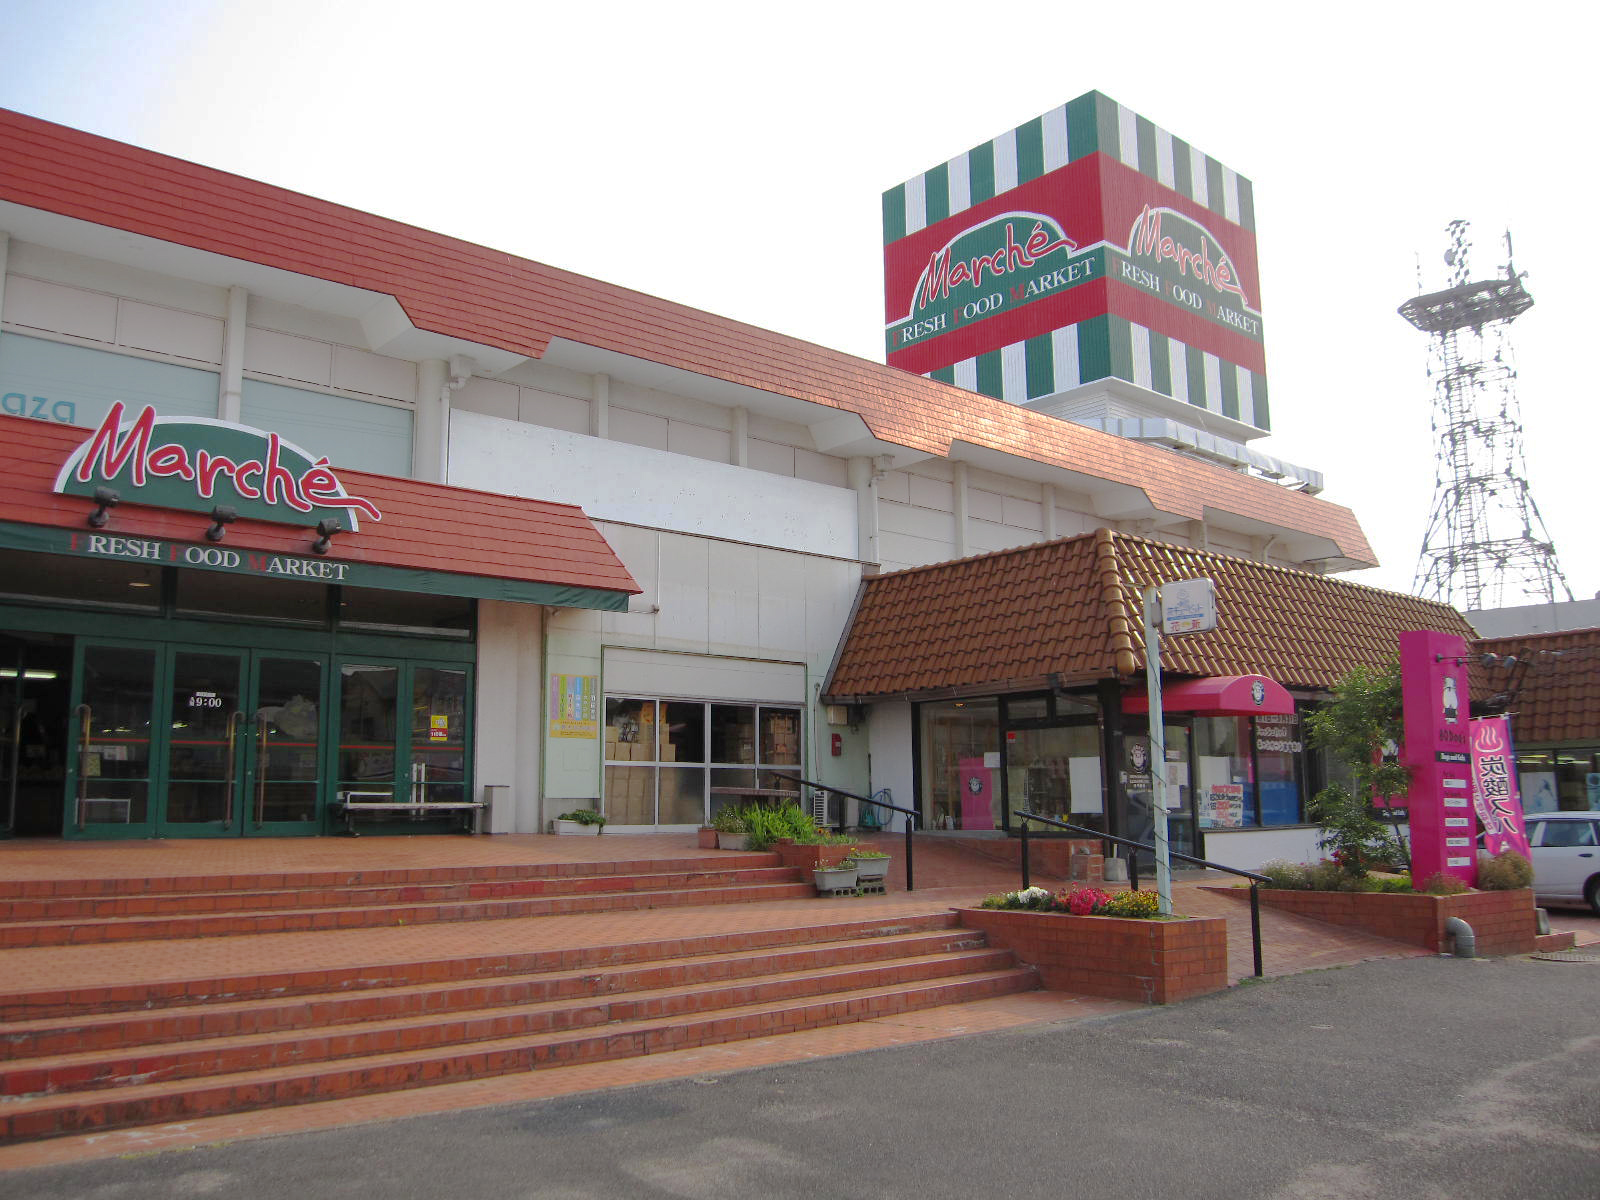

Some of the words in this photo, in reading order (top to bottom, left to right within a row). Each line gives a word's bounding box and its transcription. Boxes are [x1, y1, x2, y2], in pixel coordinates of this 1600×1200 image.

[920, 221, 1078, 310] Marché
[1136, 203, 1248, 302] Marché
[892, 312, 947, 346] FRESH
[953, 292, 1003, 325] FOOD
[1010, 257, 1096, 304] MARKET
[76, 400, 382, 522] Marché
[70, 532, 161, 561] FRESH
[170, 544, 241, 569] FOOD
[248, 554, 350, 581] MARKET
